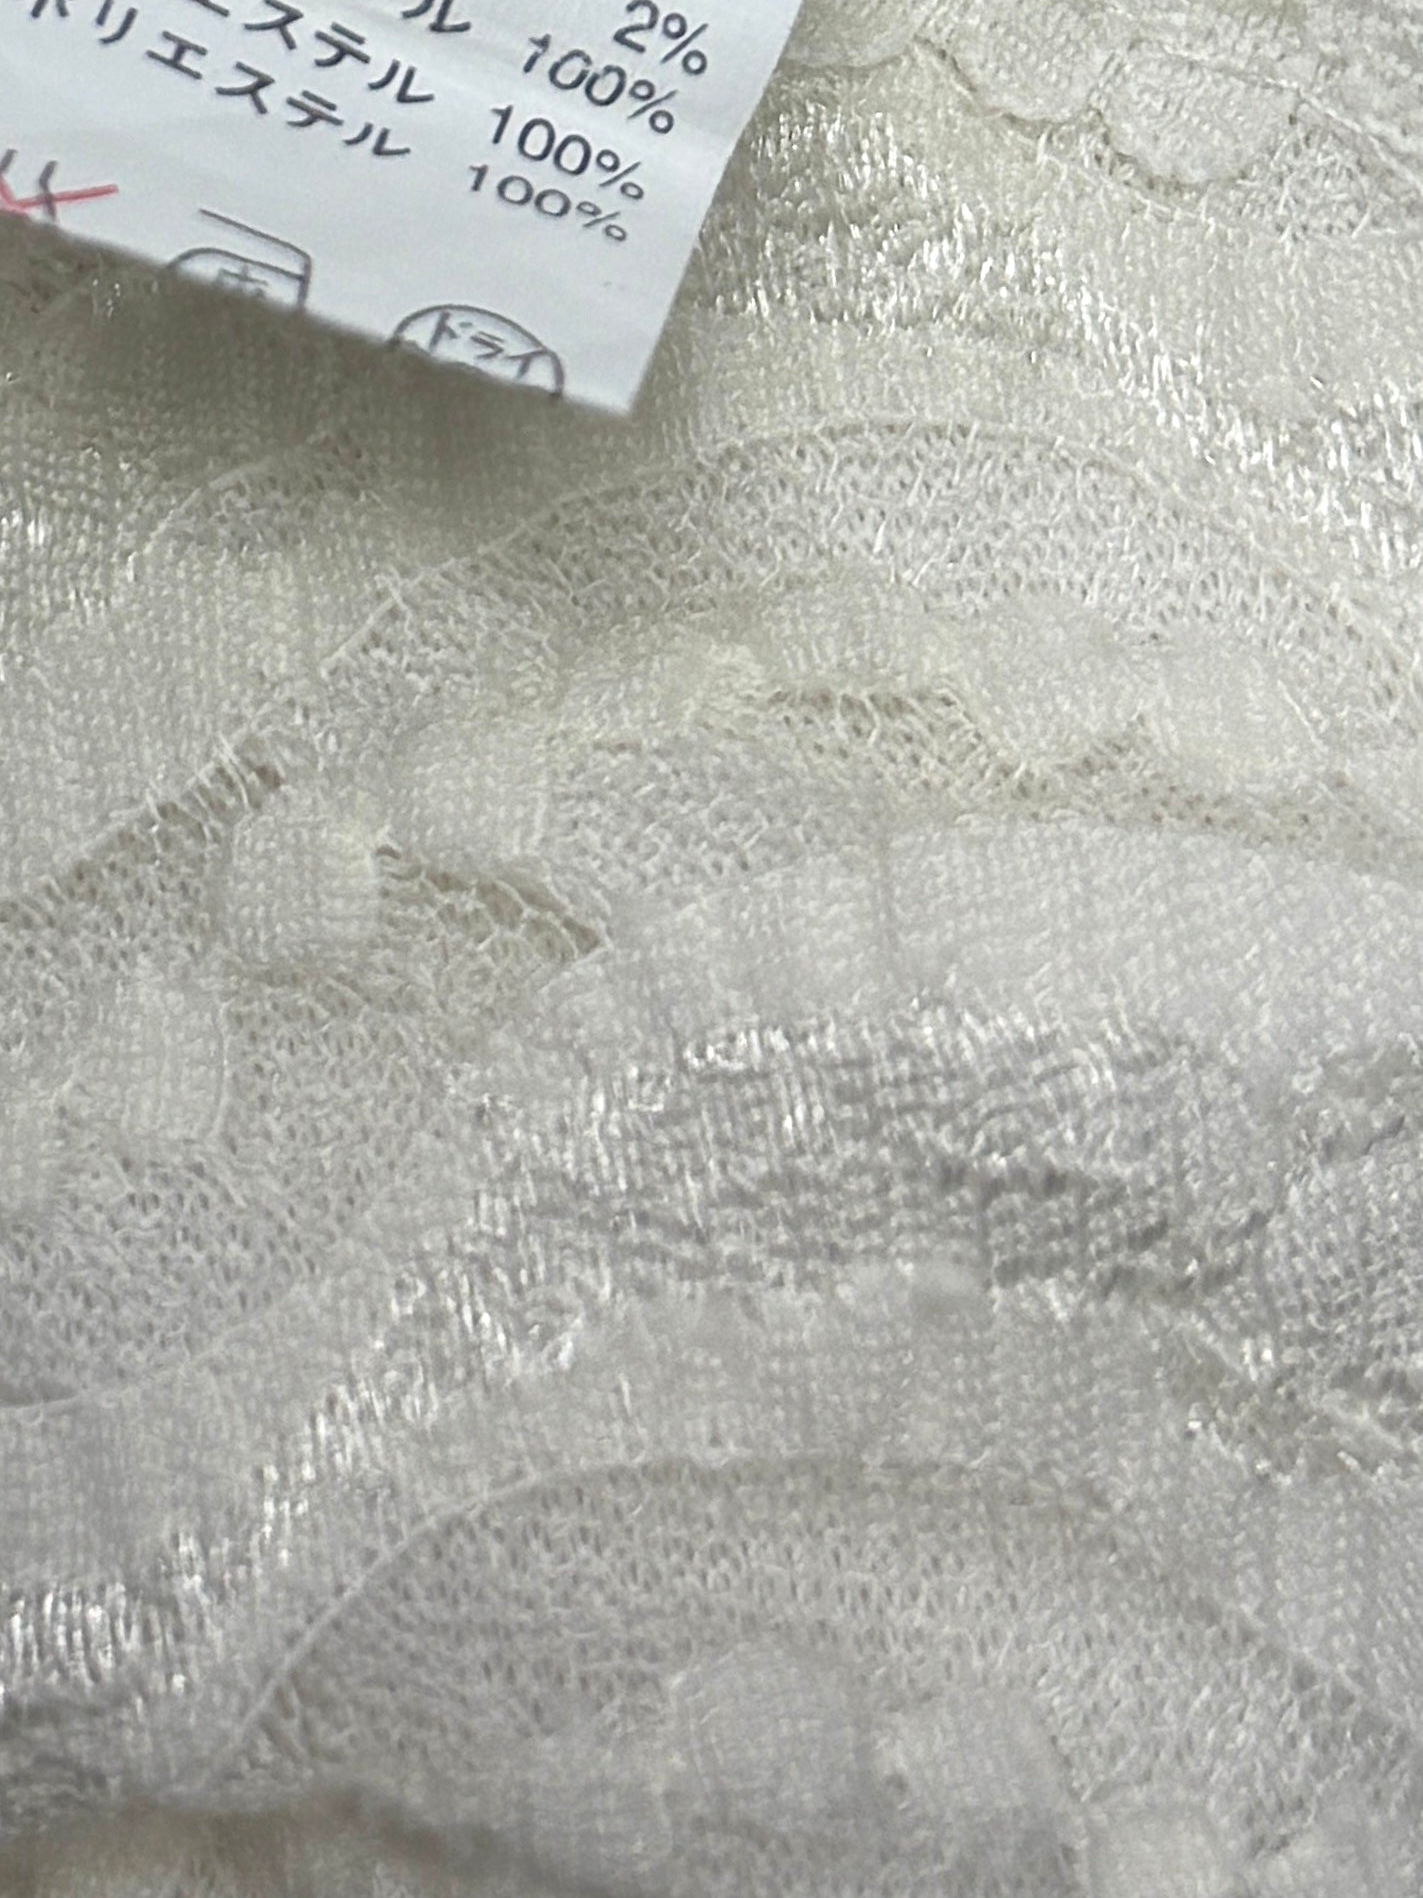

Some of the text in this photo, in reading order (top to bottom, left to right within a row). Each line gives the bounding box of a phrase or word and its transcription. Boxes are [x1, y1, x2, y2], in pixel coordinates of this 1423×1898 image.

[522, 32, 678, 135] 100%
[490, 103, 645, 201] 100%
[468, 163, 628, 242] 100%
